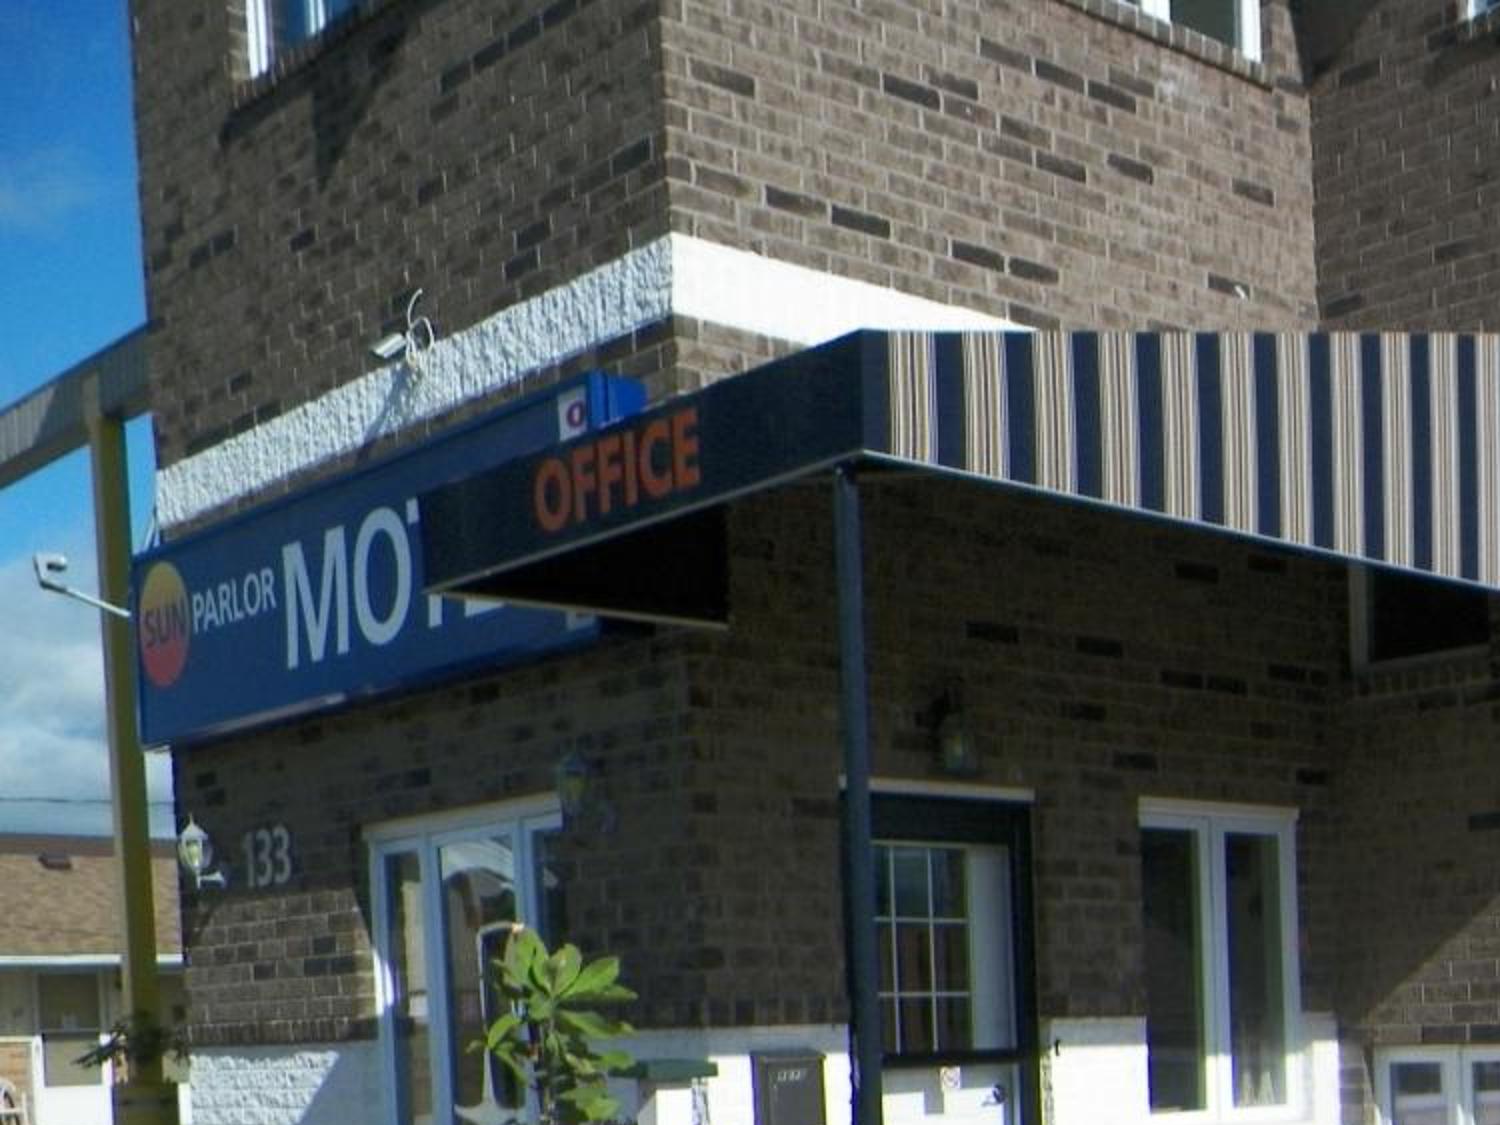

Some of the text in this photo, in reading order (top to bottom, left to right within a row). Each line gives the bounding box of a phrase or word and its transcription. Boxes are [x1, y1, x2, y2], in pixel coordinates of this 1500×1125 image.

[535, 408, 700, 531] OFFICE
[146, 568, 277, 648] SUN PARLOR
[244, 826, 291, 888] 133
